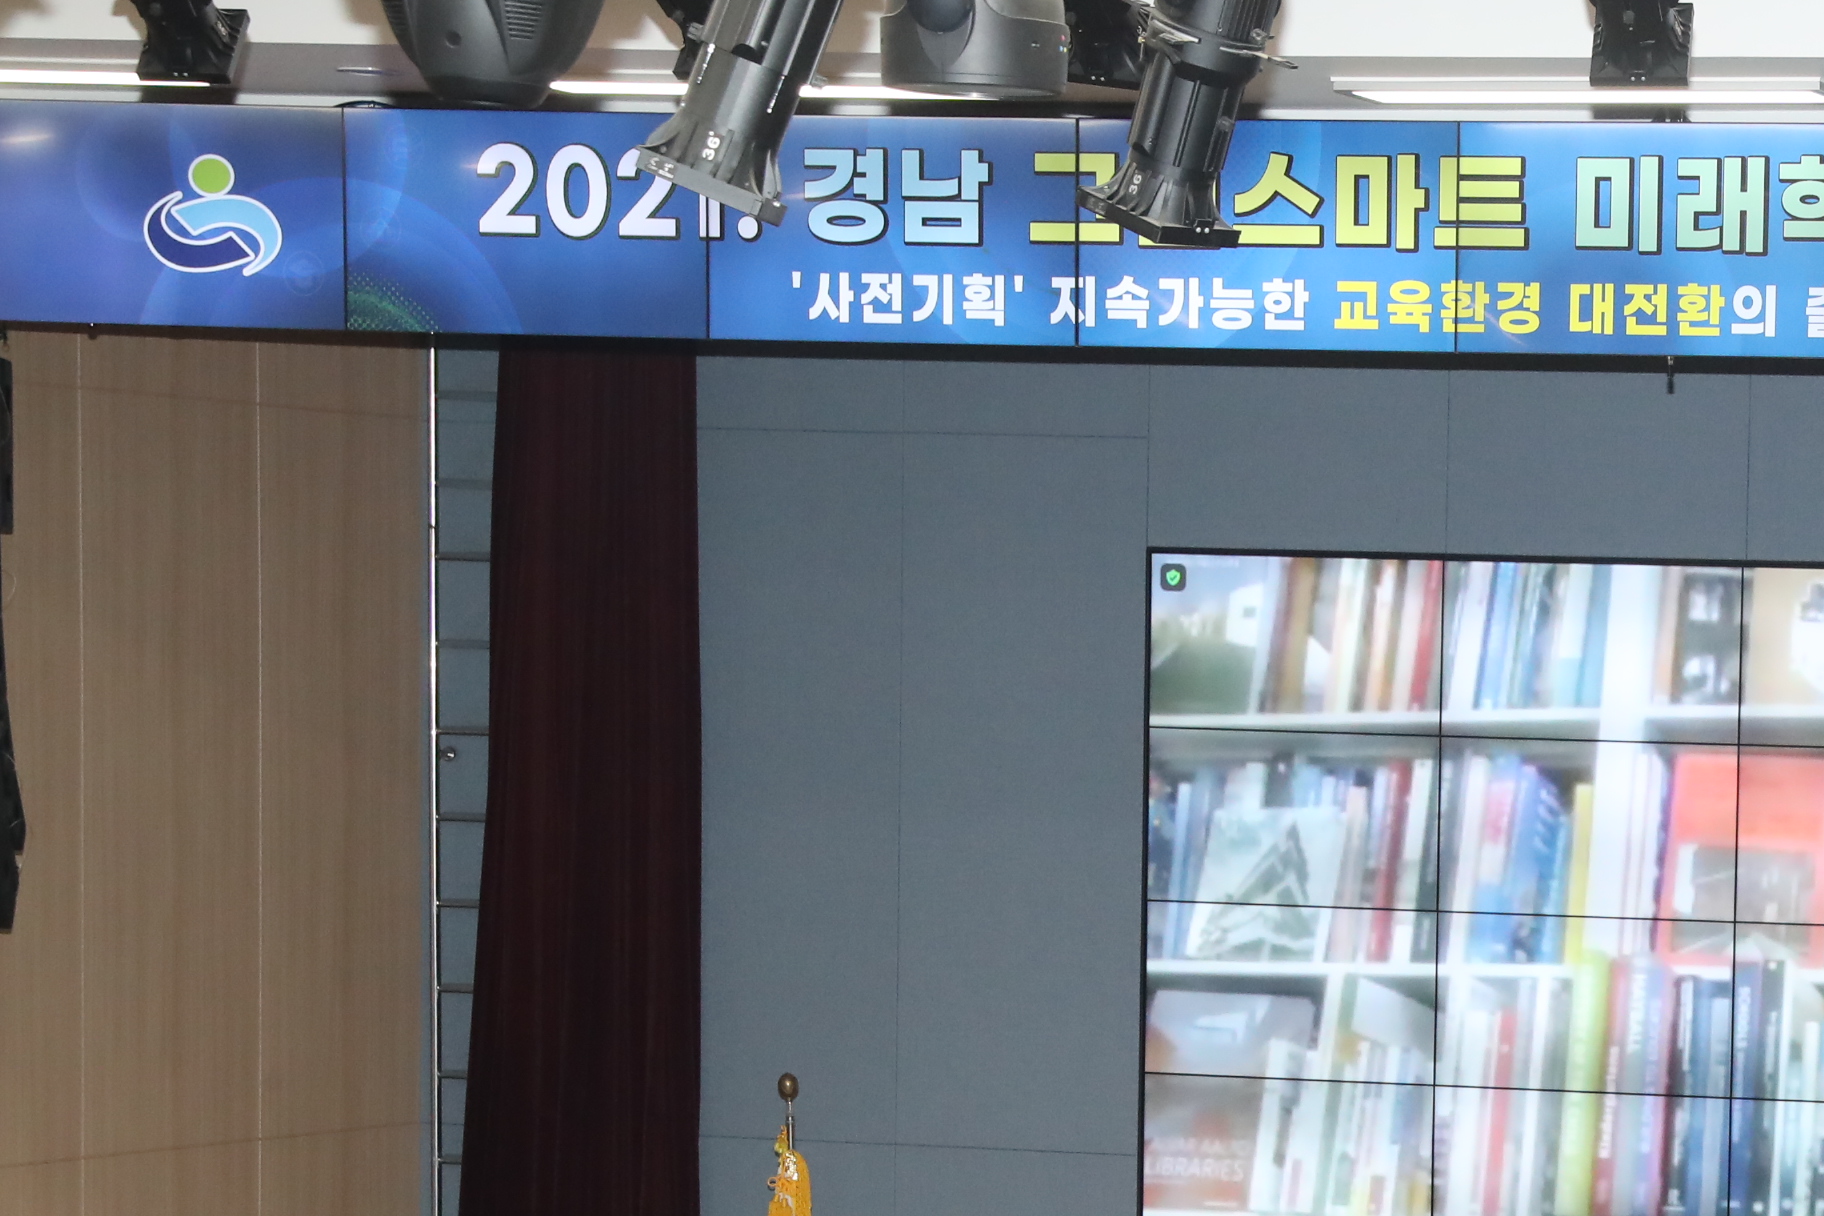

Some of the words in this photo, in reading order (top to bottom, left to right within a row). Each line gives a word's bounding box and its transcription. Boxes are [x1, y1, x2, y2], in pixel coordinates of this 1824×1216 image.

[803, 147, 992, 247] 경남
[1029, 149, 1528, 252] 그스마트
[792, 271, 1024, 327] '사전기획'
[1049, 276, 1309, 330] 지속가능한
[1334, 279, 1541, 335] 교육환경
[1568, 282, 1777, 338] 대전환의
